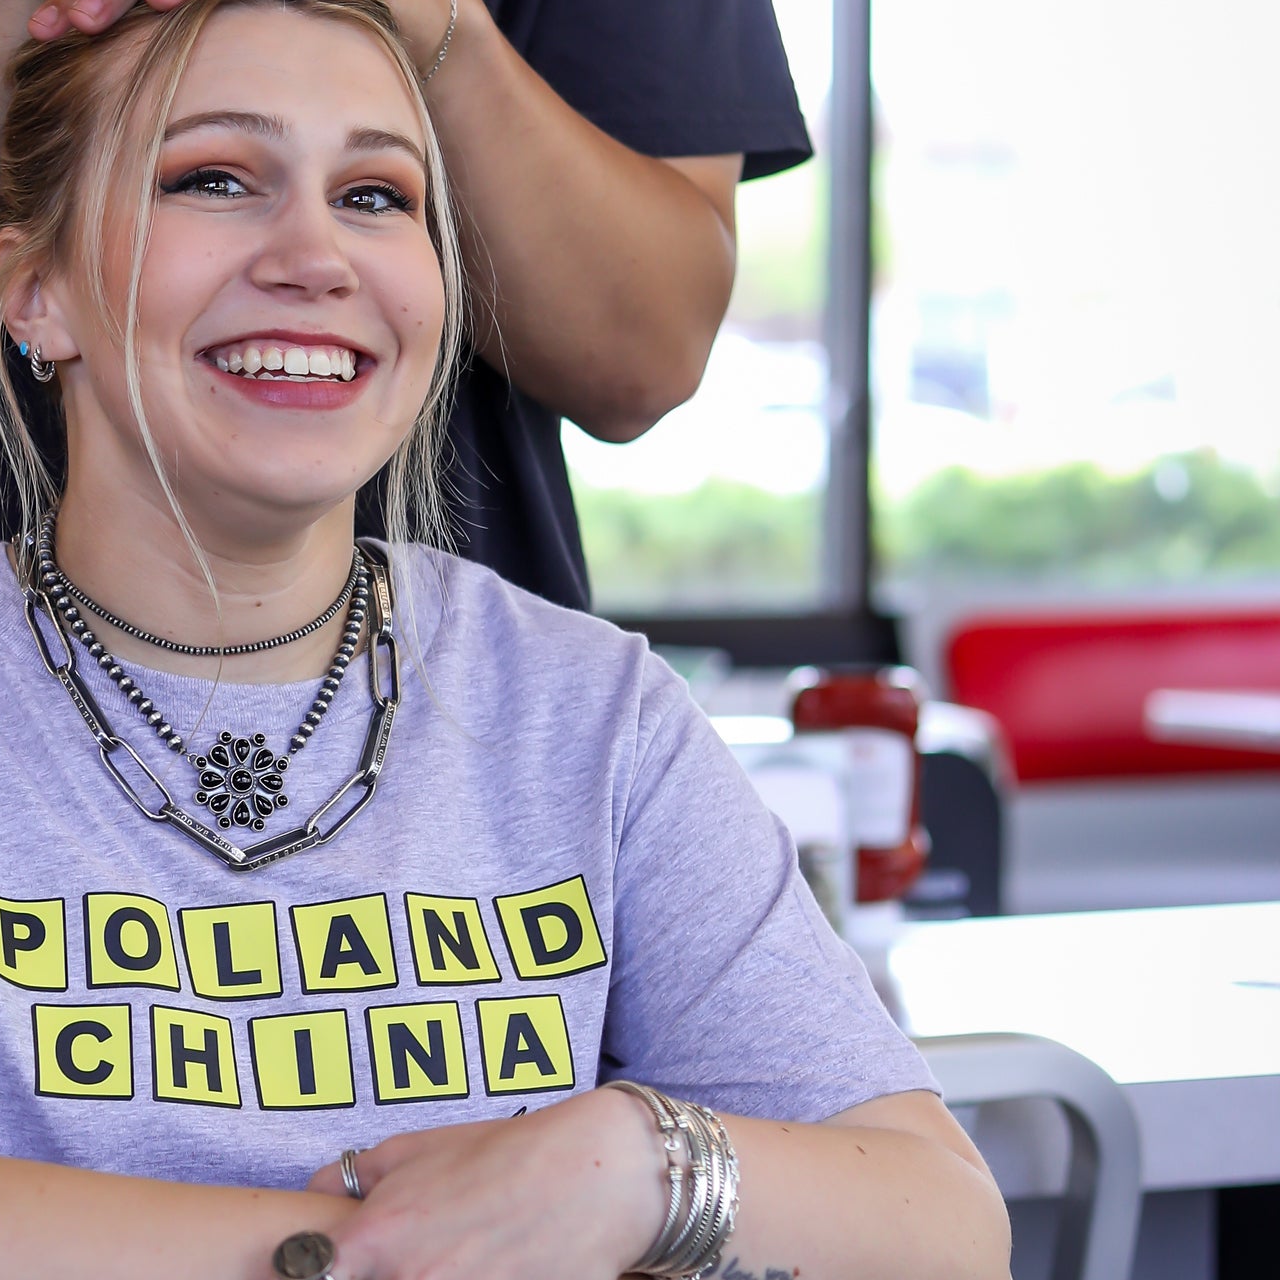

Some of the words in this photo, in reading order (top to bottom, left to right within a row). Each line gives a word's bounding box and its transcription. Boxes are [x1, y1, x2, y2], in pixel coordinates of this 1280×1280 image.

[62, 678, 97, 731] LIBERTY
[375, 749, 385, 767] GOD
[380, 734, 388, 747] WE
[175, 811, 193, 825] GOD
[195, 824, 209, 837] WE
[0, 902, 584, 988] POLAND
[55, 1012, 559, 1096] CHINA
